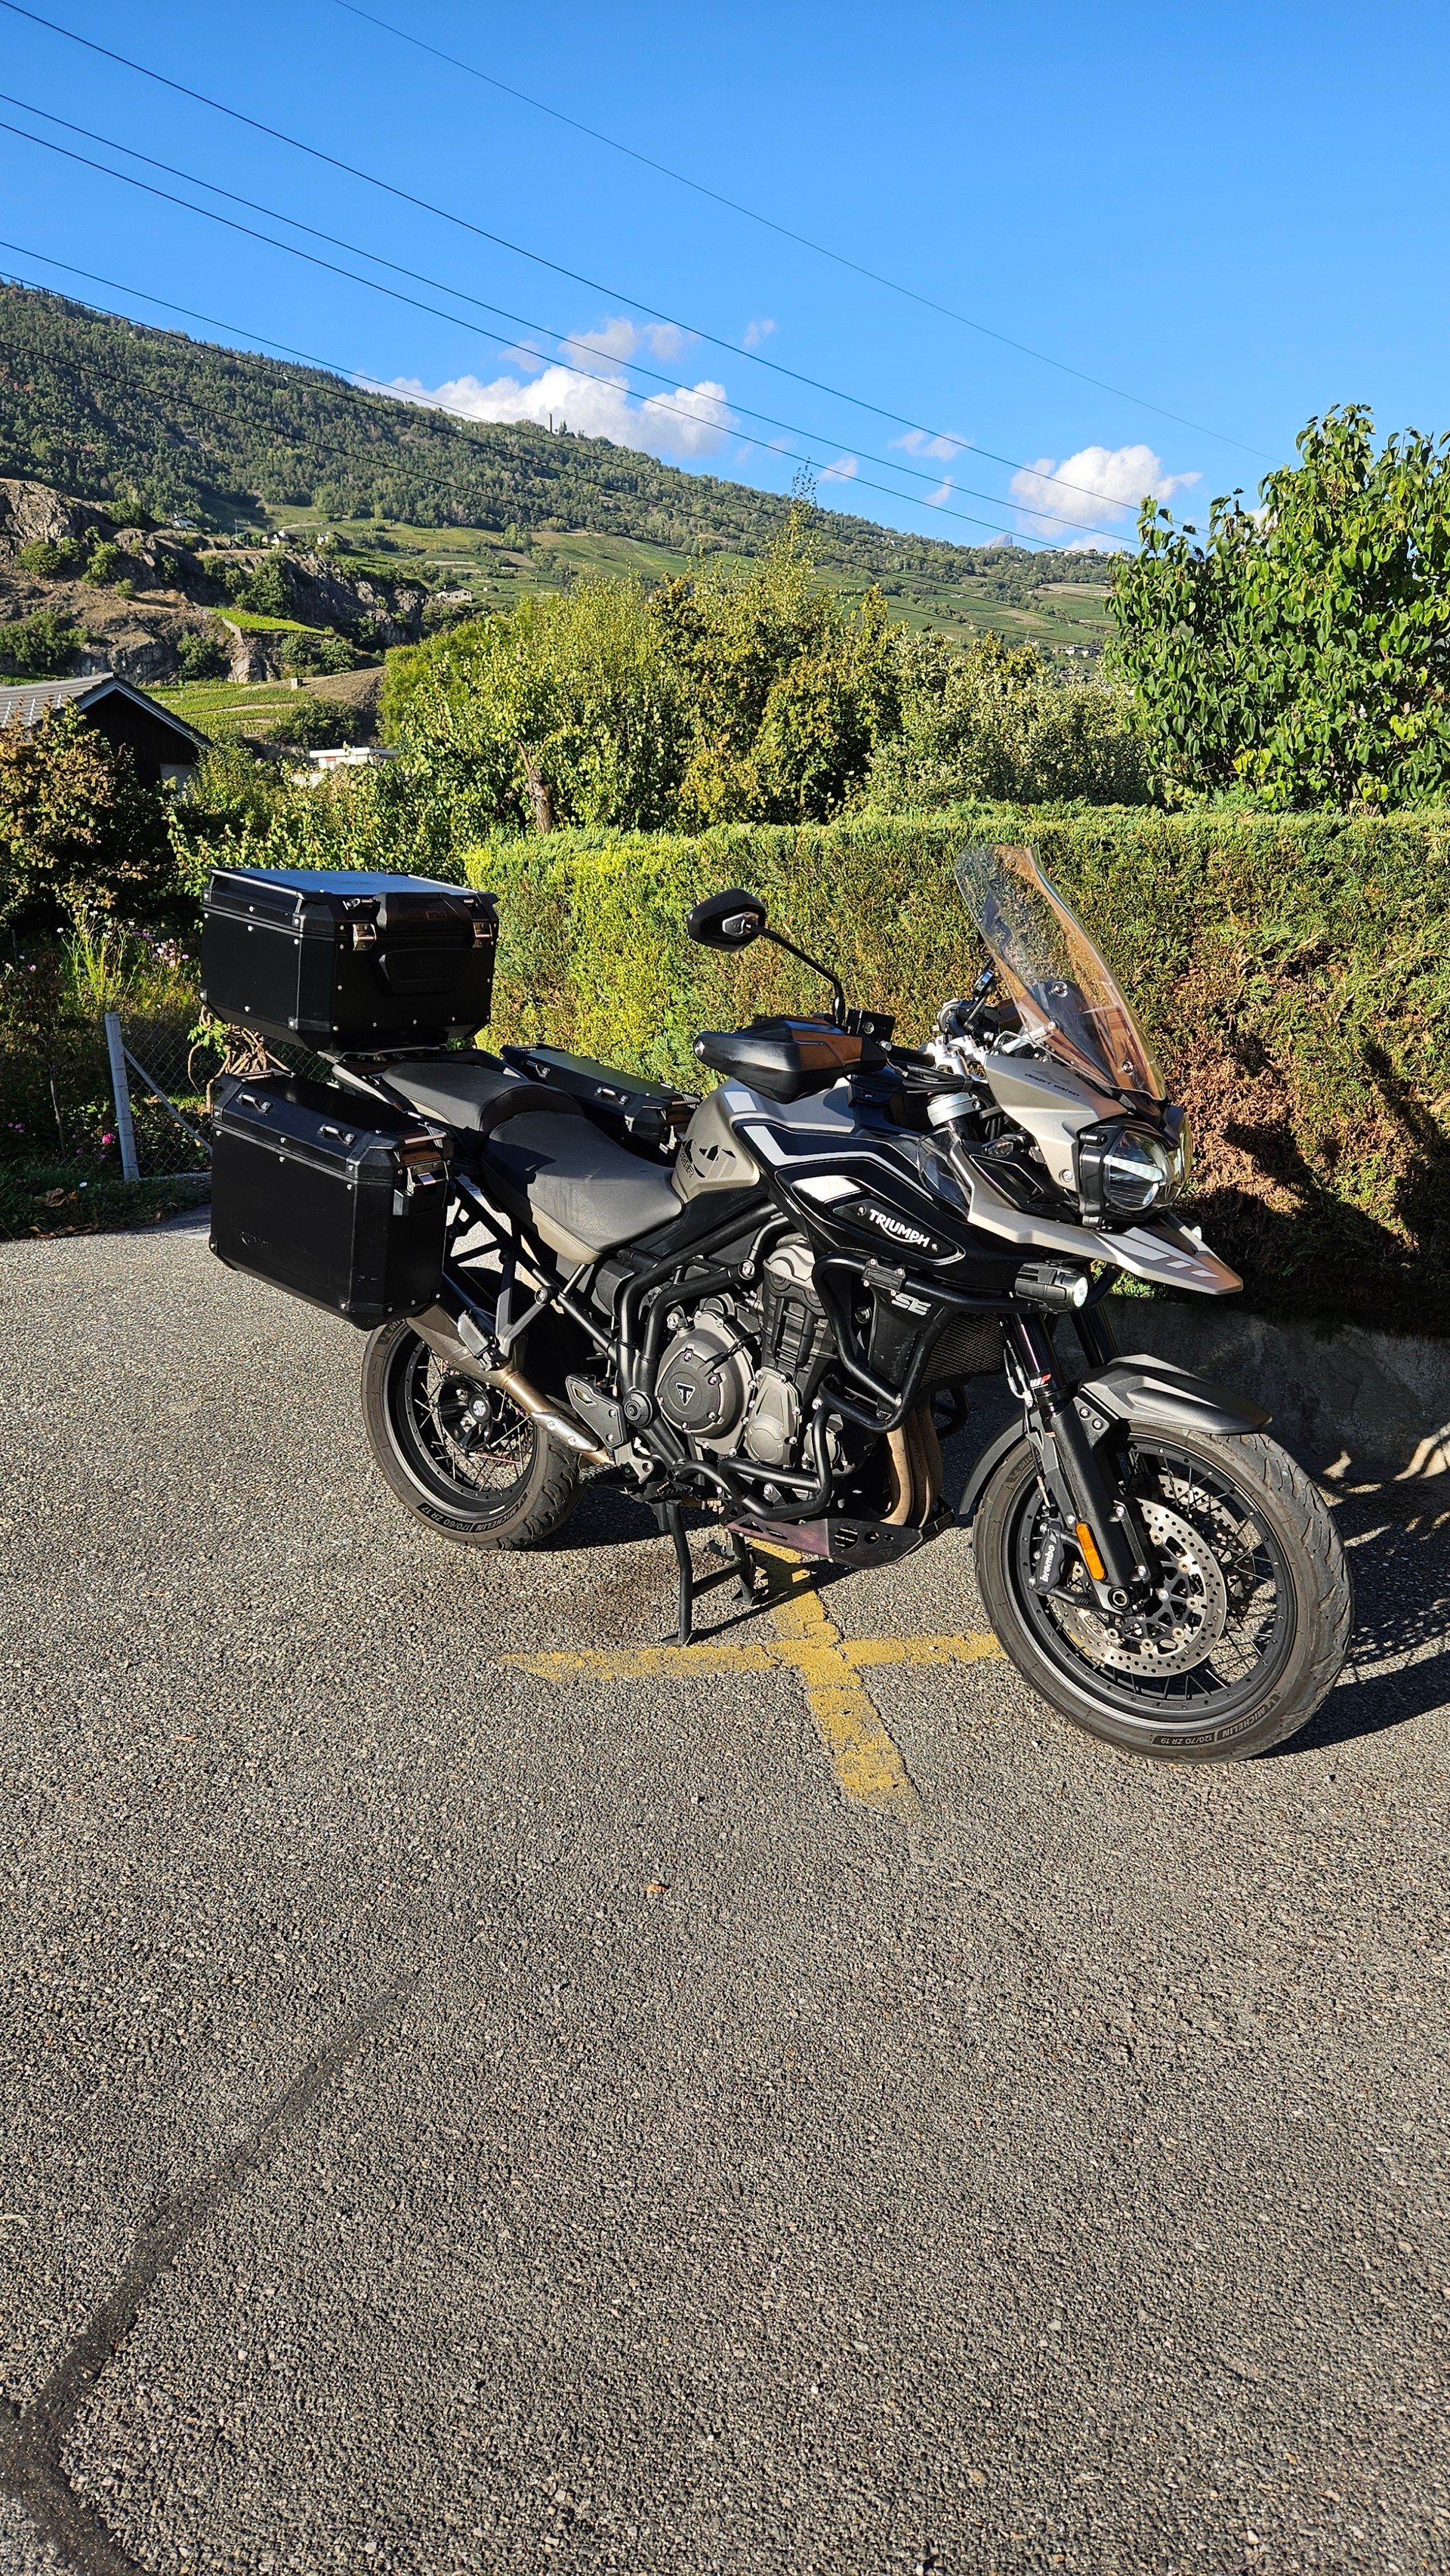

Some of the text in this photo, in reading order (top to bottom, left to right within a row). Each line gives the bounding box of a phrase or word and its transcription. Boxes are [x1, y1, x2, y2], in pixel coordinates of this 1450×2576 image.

[869, 1209, 930, 1248] TRIUMPH
[891, 1293, 932, 1316] SE
[1029, 1373, 1051, 1388] WP
[421, 1506, 517, 1532] MICHELIN 170/60 ZR 17
[1039, 1544, 1056, 1583] brembo
[1222, 1709, 1266, 1738] MICHELIN
[1185, 1735, 1213, 1744] 120/70
